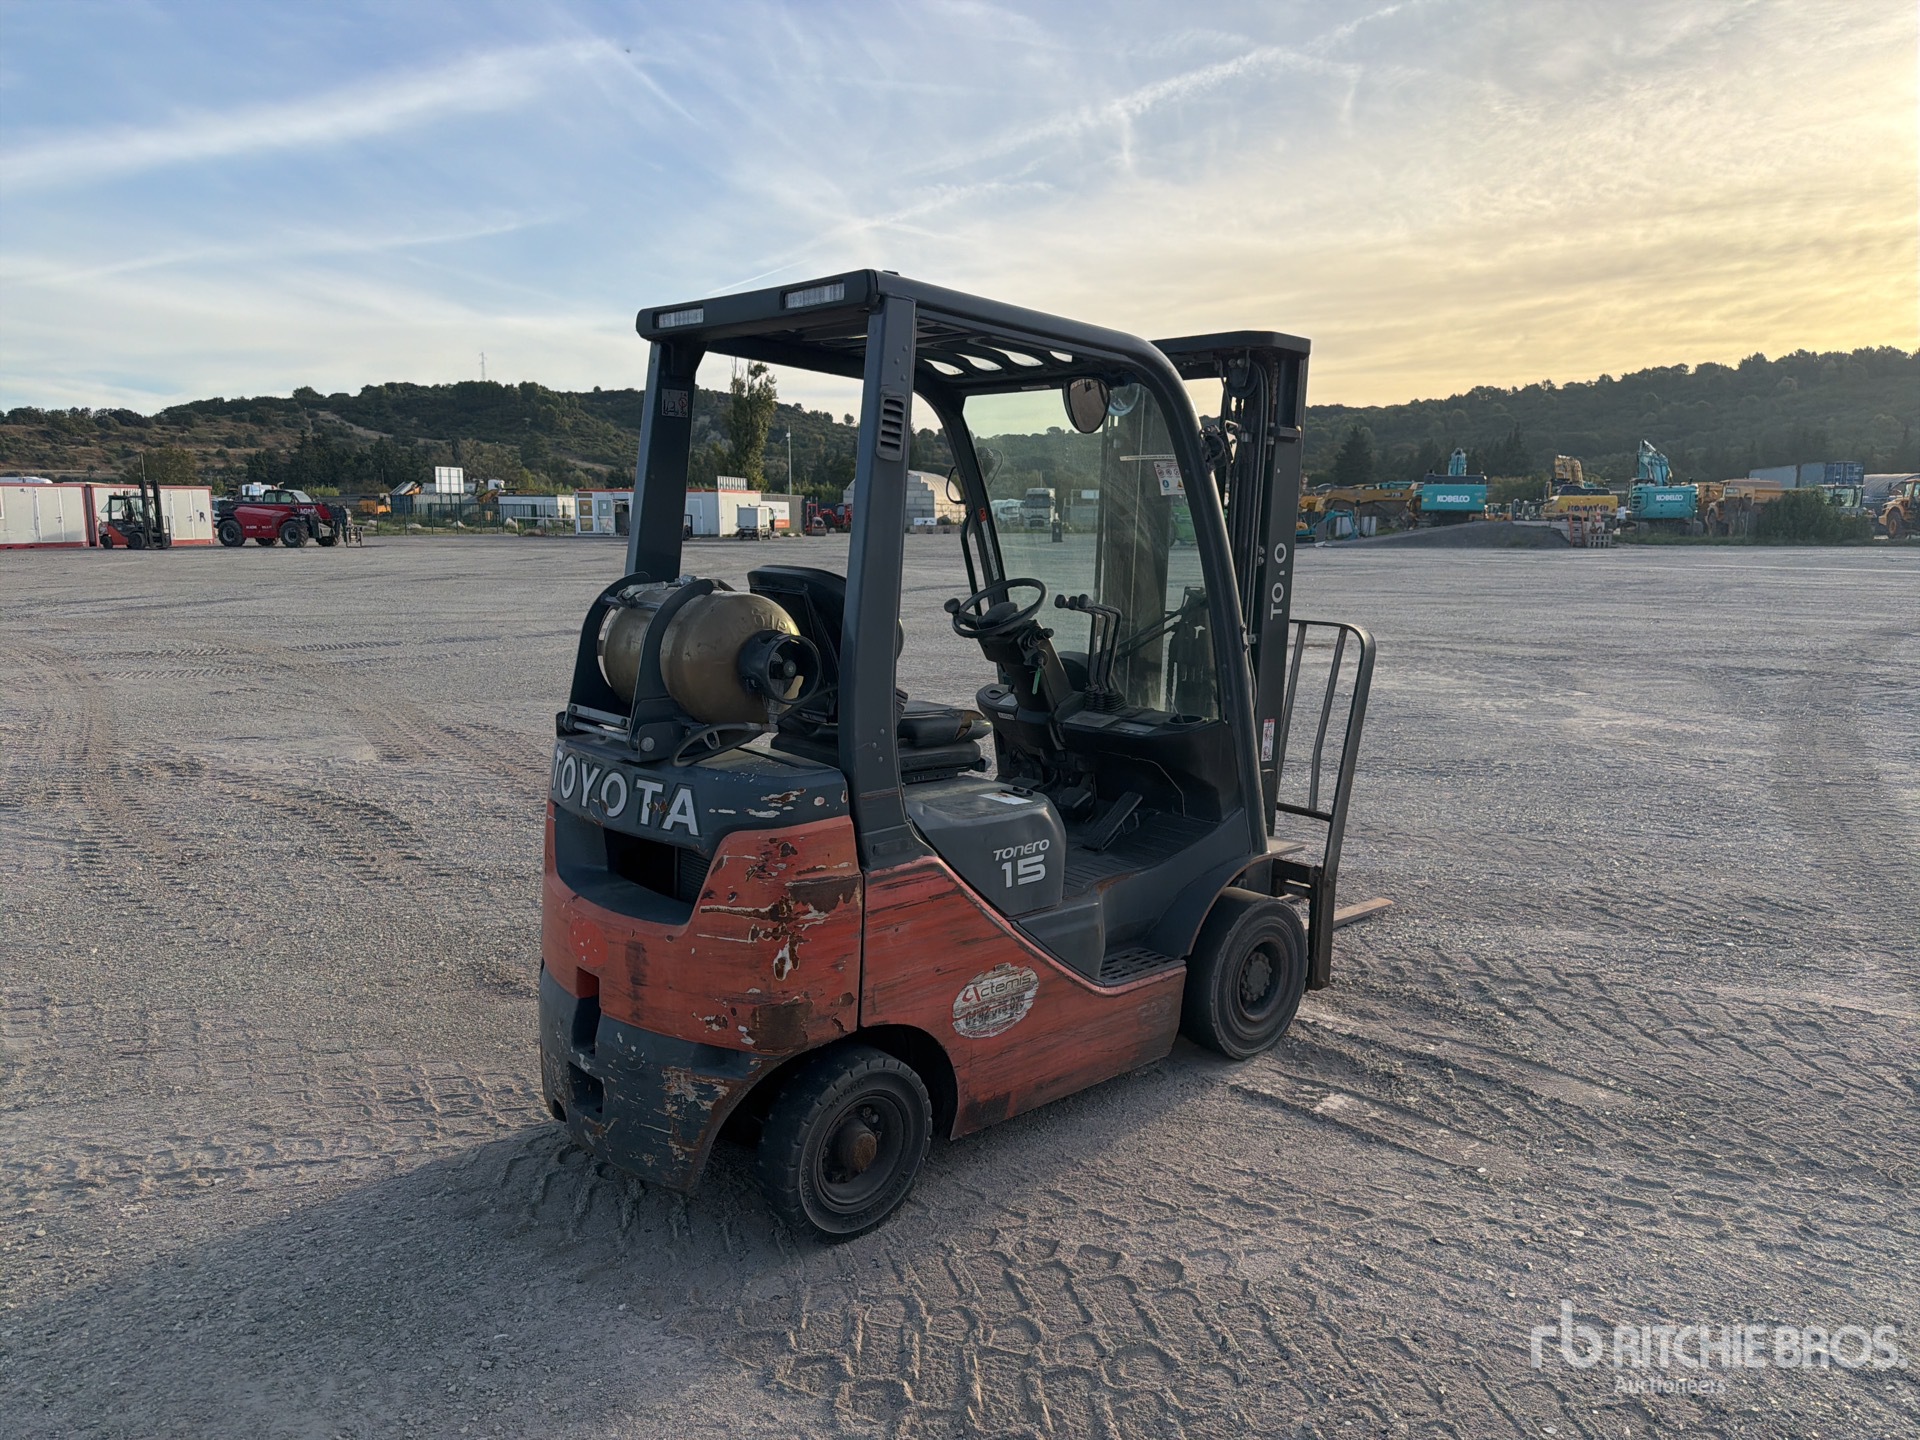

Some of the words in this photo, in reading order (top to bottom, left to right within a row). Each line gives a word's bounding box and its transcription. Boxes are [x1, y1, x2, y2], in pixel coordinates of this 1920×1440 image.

[1436, 495, 1470, 503] KOBELCO
[1656, 494, 1684, 502] KOBELCO
[552, 747, 700, 836] TOYOTA
[1001, 854, 1046, 888] 15
